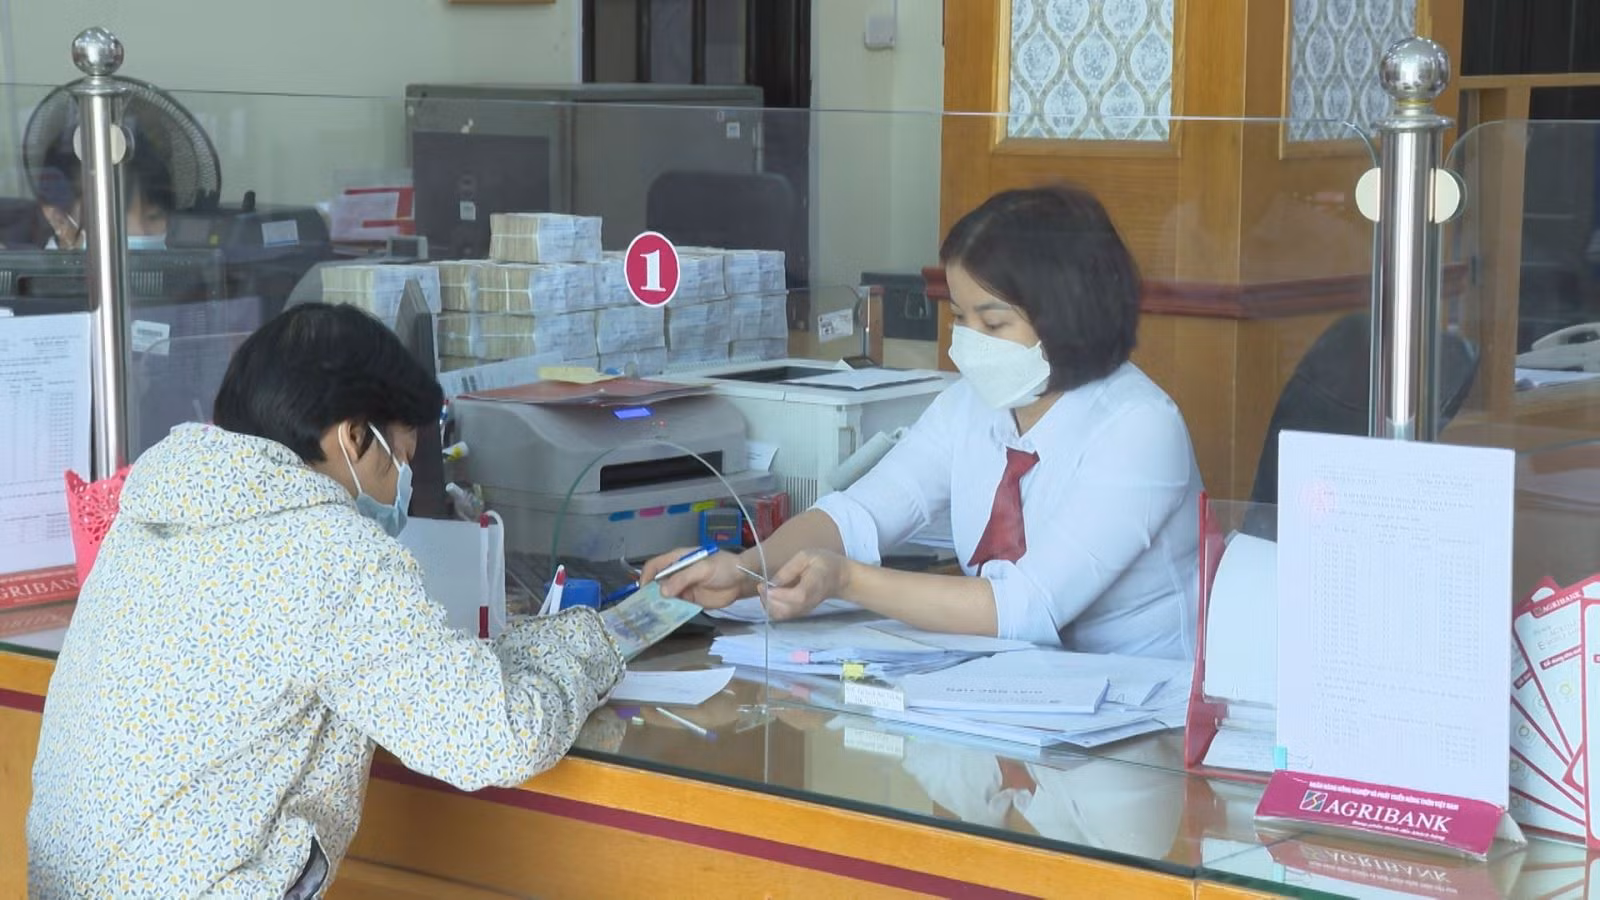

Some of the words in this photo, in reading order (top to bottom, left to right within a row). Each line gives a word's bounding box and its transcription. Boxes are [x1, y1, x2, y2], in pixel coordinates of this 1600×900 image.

[640, 249, 666, 292] 1
[0, 577, 78, 599] GRIBAN
[1324, 799, 1452, 833] AGRIBANK
